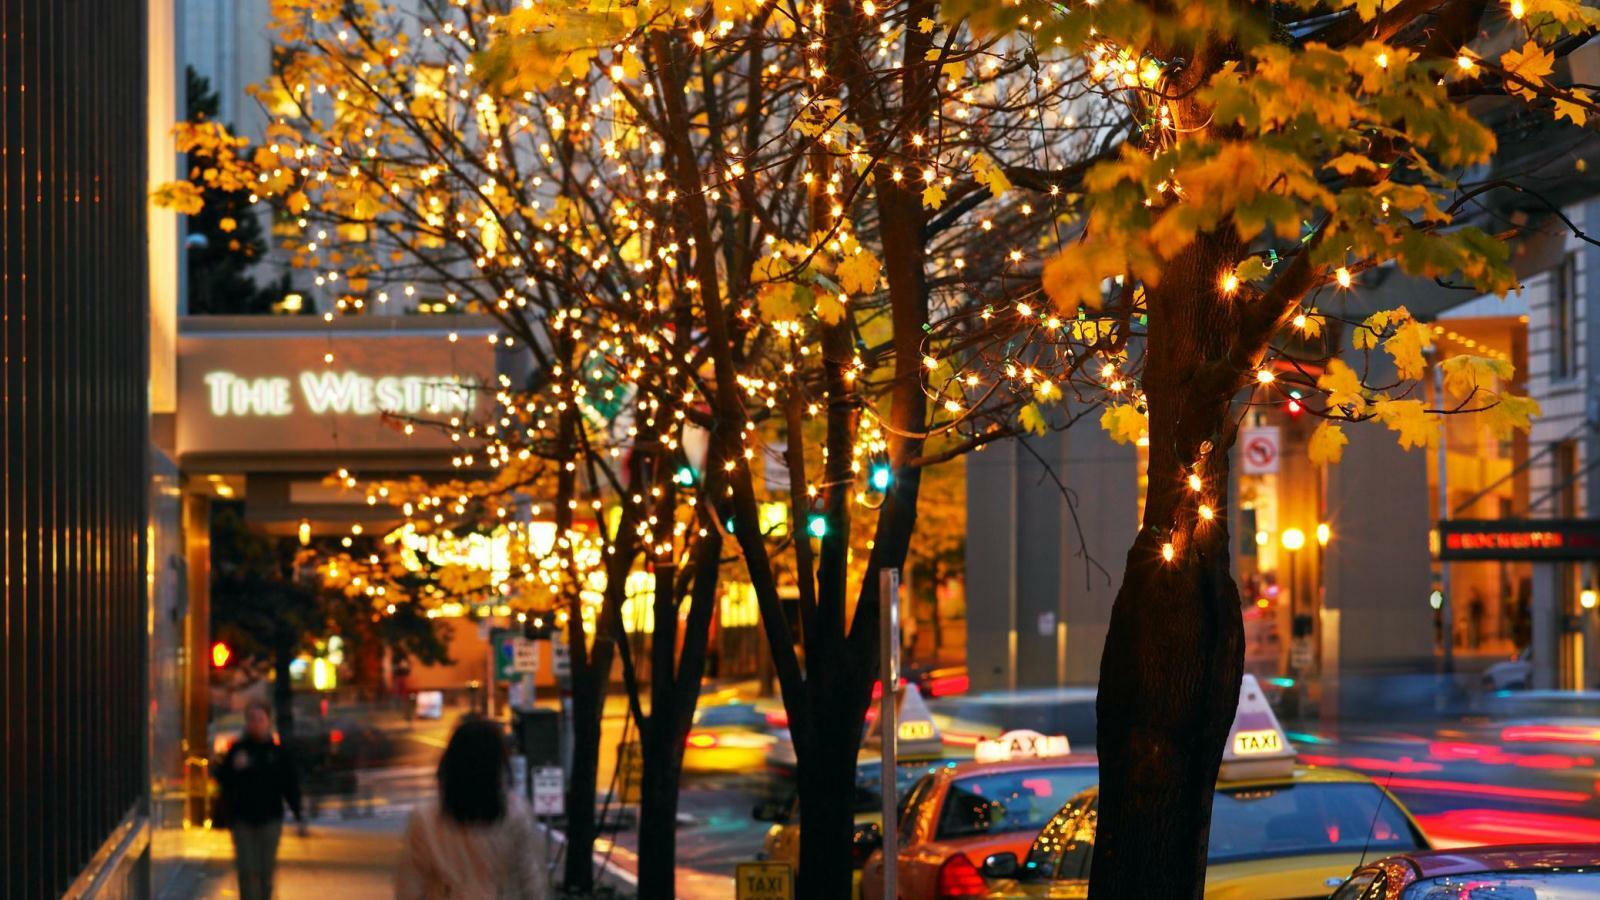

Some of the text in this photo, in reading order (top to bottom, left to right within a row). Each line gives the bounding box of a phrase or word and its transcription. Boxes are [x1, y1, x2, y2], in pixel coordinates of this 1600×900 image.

[205, 372, 293, 415] THE
[1238, 735, 1277, 750] TAXI
[747, 877, 782, 892] TAXI
